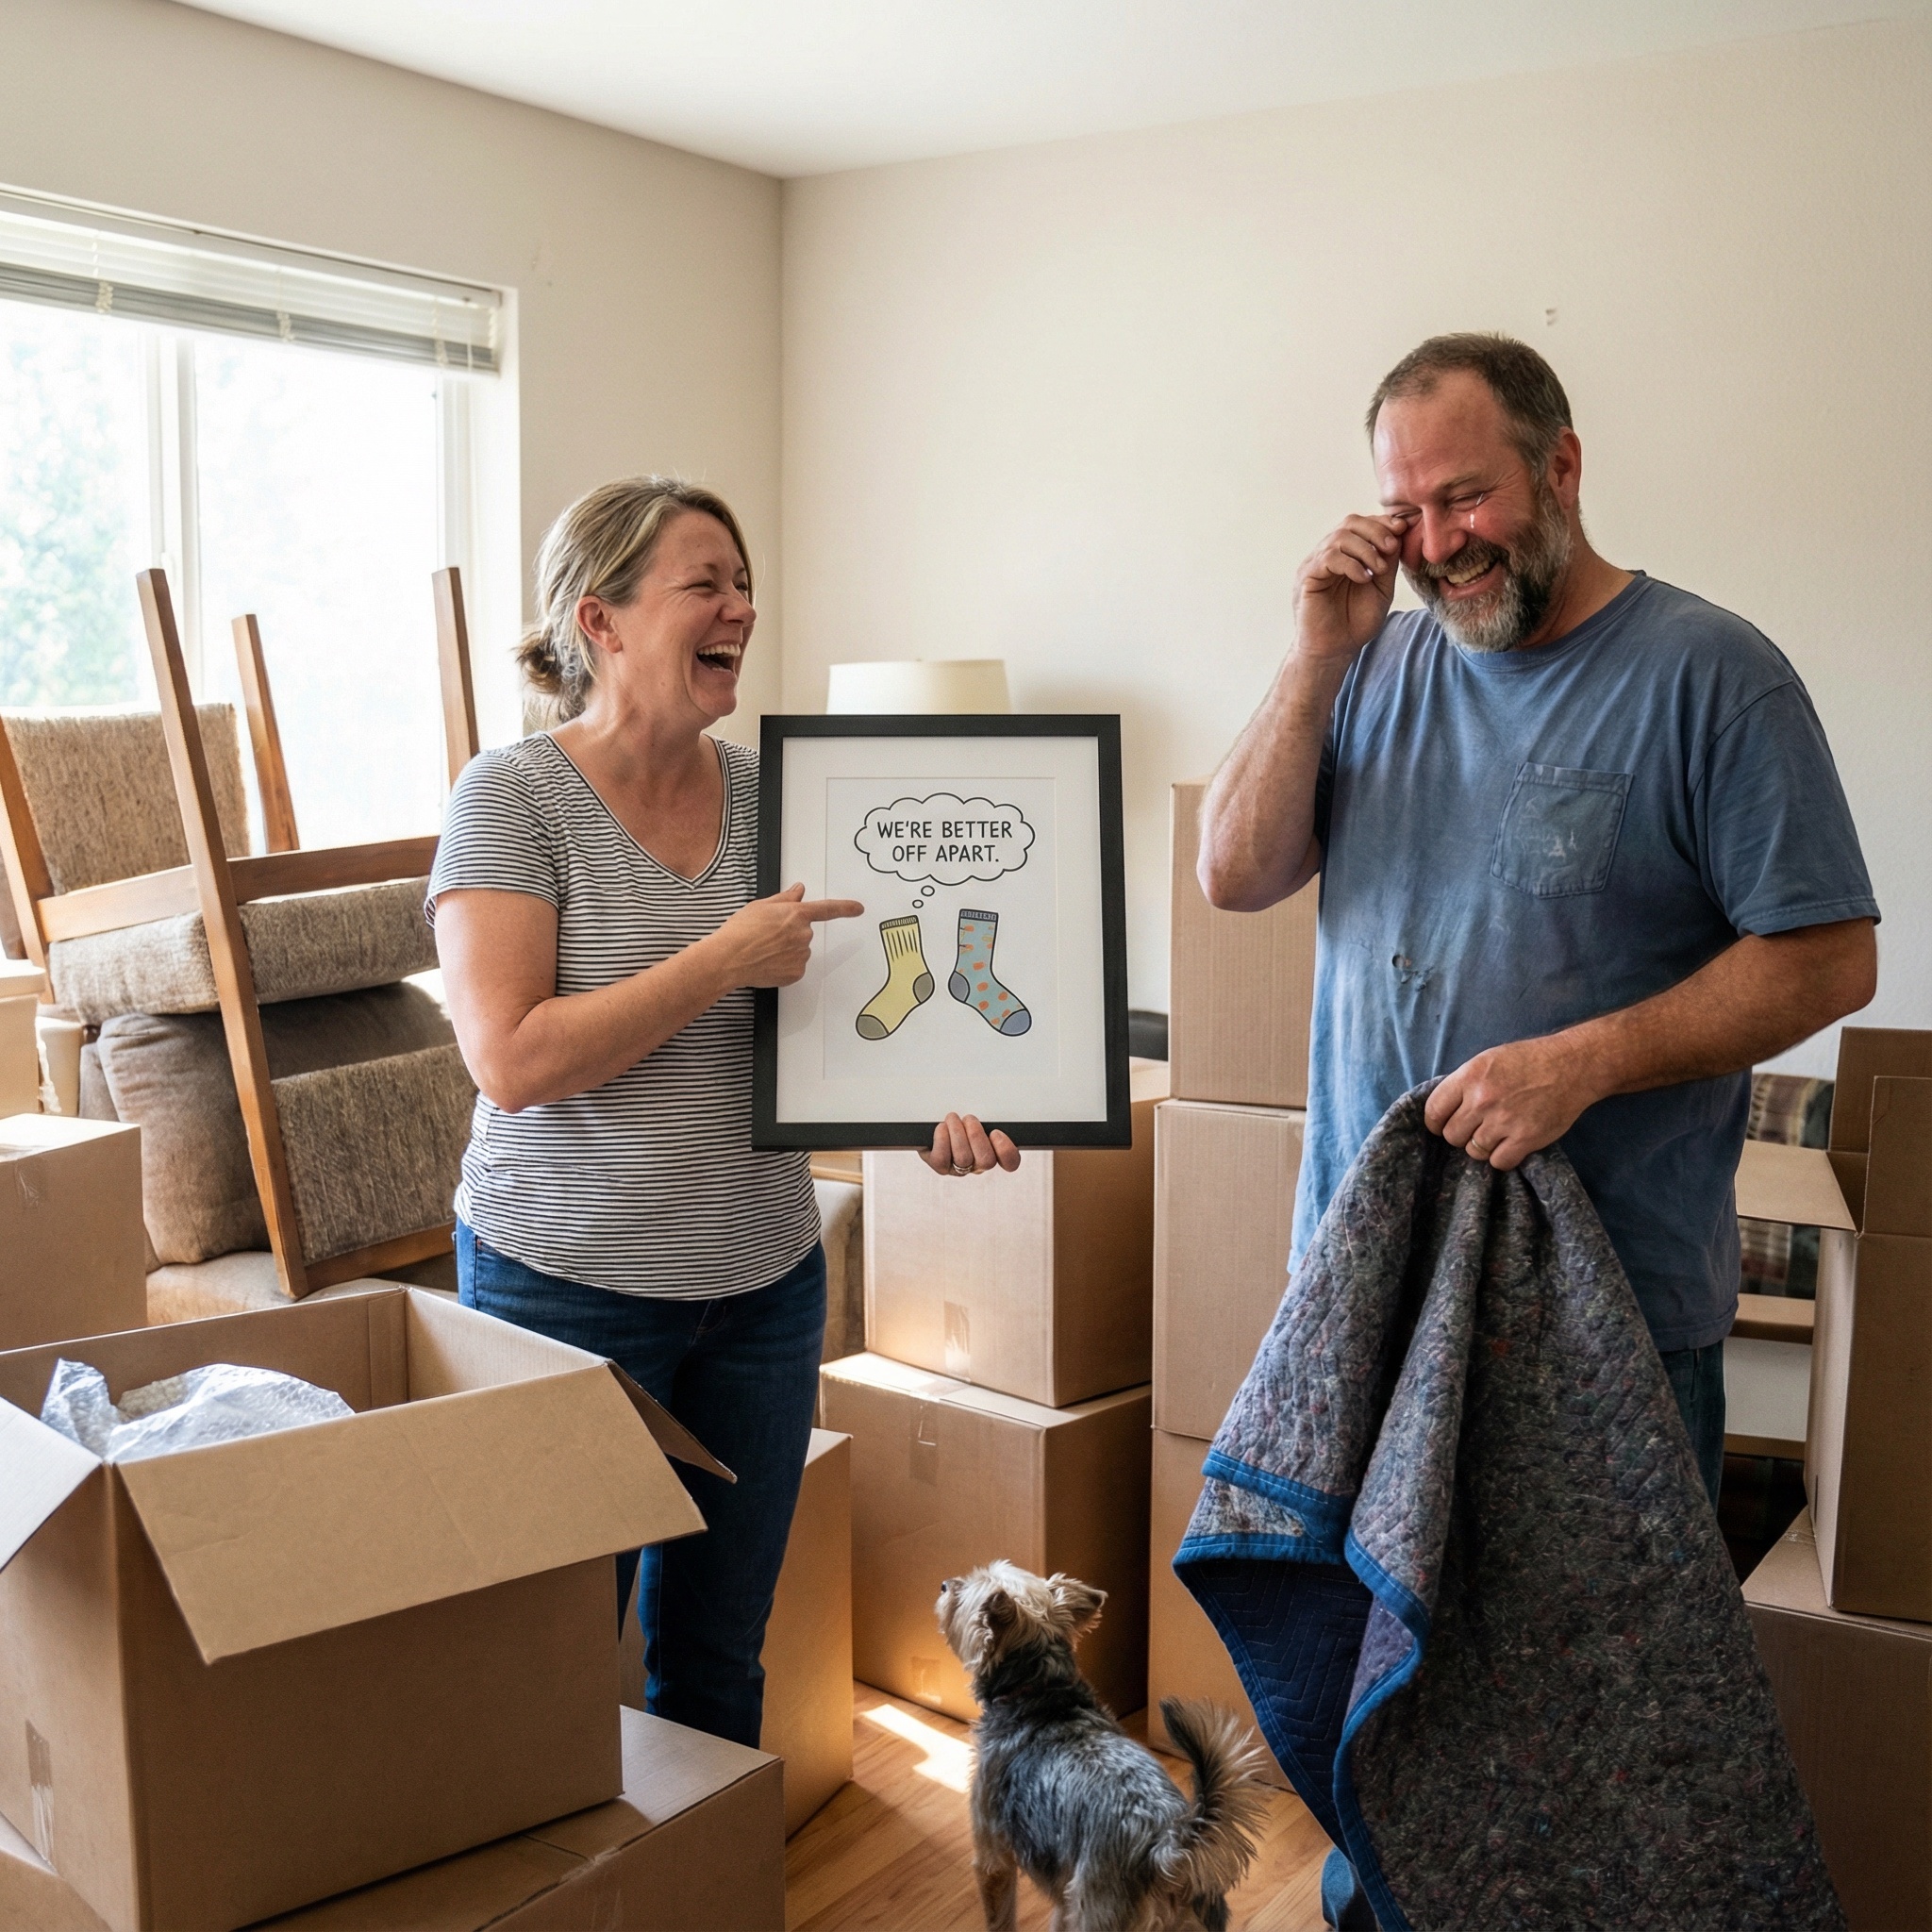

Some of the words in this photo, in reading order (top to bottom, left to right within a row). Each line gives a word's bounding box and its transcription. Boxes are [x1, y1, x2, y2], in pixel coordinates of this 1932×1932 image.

[876, 821, 932, 839] WE'RE
[941, 821, 1013, 839] BETTER
[891, 844, 927, 862] OFF
[935, 844, 1000, 862] APART.
